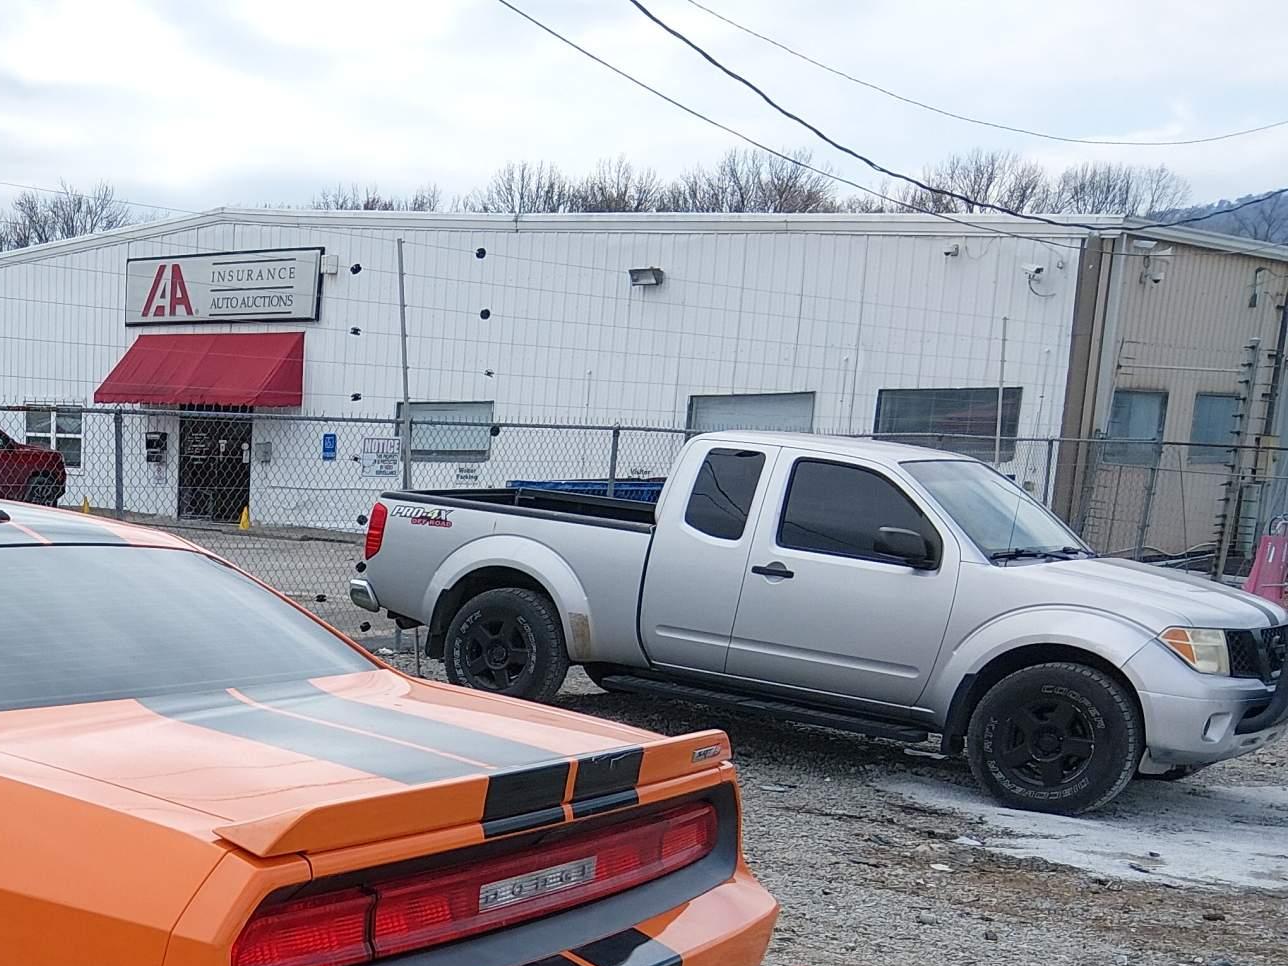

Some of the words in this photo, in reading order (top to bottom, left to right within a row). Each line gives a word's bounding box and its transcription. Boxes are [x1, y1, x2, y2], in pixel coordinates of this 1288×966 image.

[211, 266, 296, 283] INSURANCE
[209, 297, 239, 310] AUTO
[239, 294, 293, 308] AUCTIONS
[363, 438, 400, 454] NOTICE
[390, 505, 454, 521] PRO-4X
[428, 519, 453, 528] ROAD
[1041, 685, 1106, 730] COOPER
[986, 759, 1090, 800] DISCOVERER
